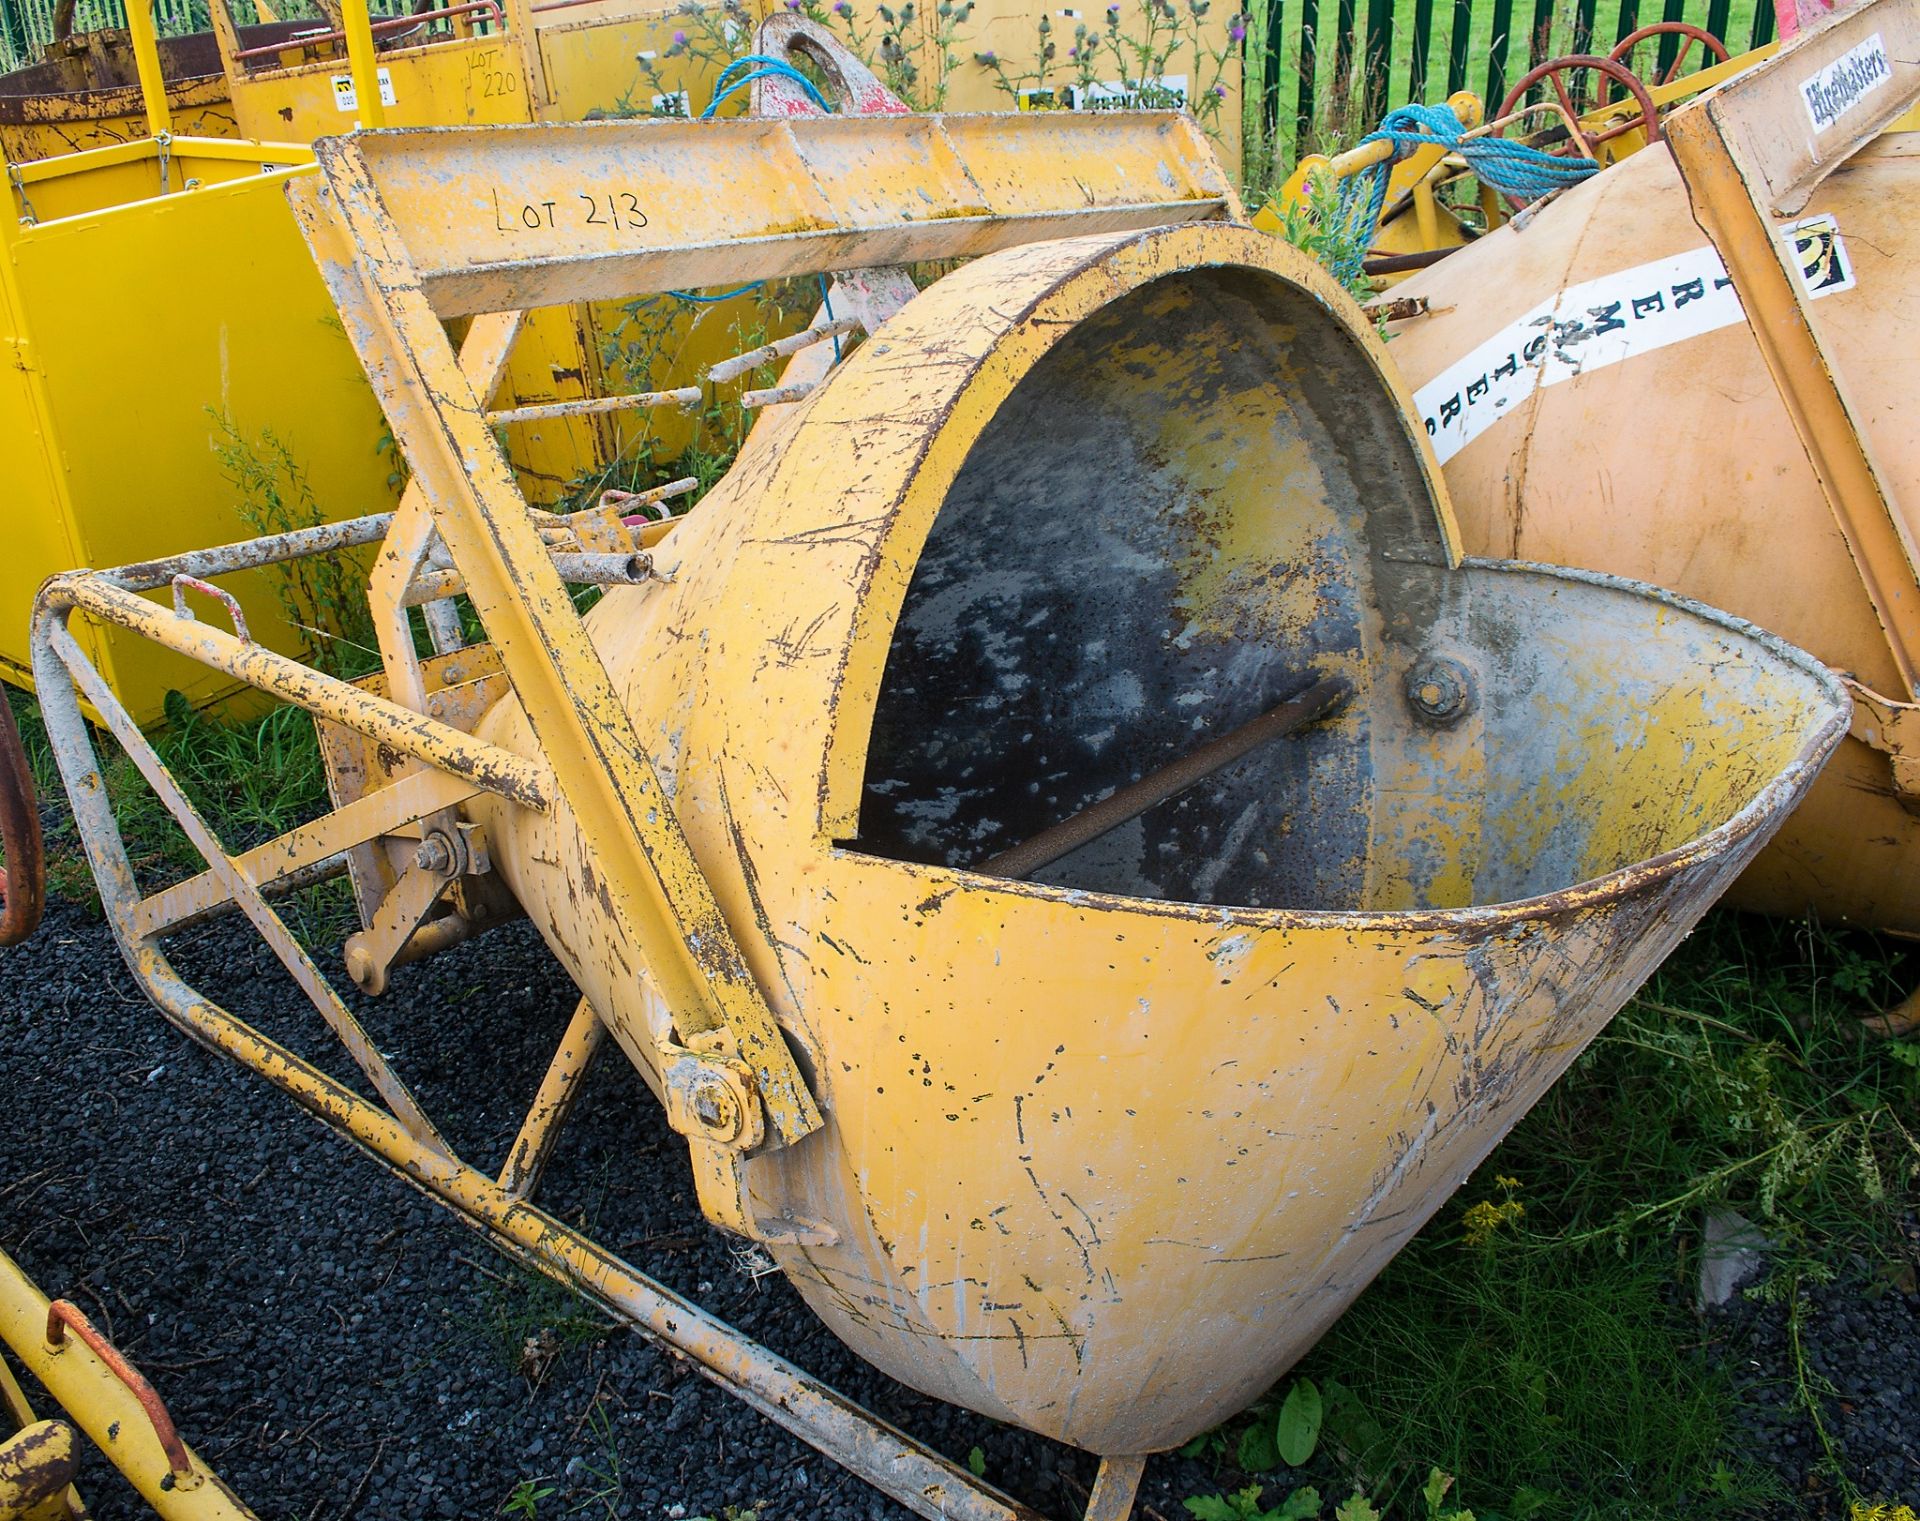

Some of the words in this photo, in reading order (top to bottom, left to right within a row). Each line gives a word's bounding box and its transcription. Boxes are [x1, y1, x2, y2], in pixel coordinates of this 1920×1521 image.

[471, 49, 499, 70] LOT
[484, 71, 517, 98] 220
[492, 187, 557, 232] LOT
[579, 192, 649, 231] 213
